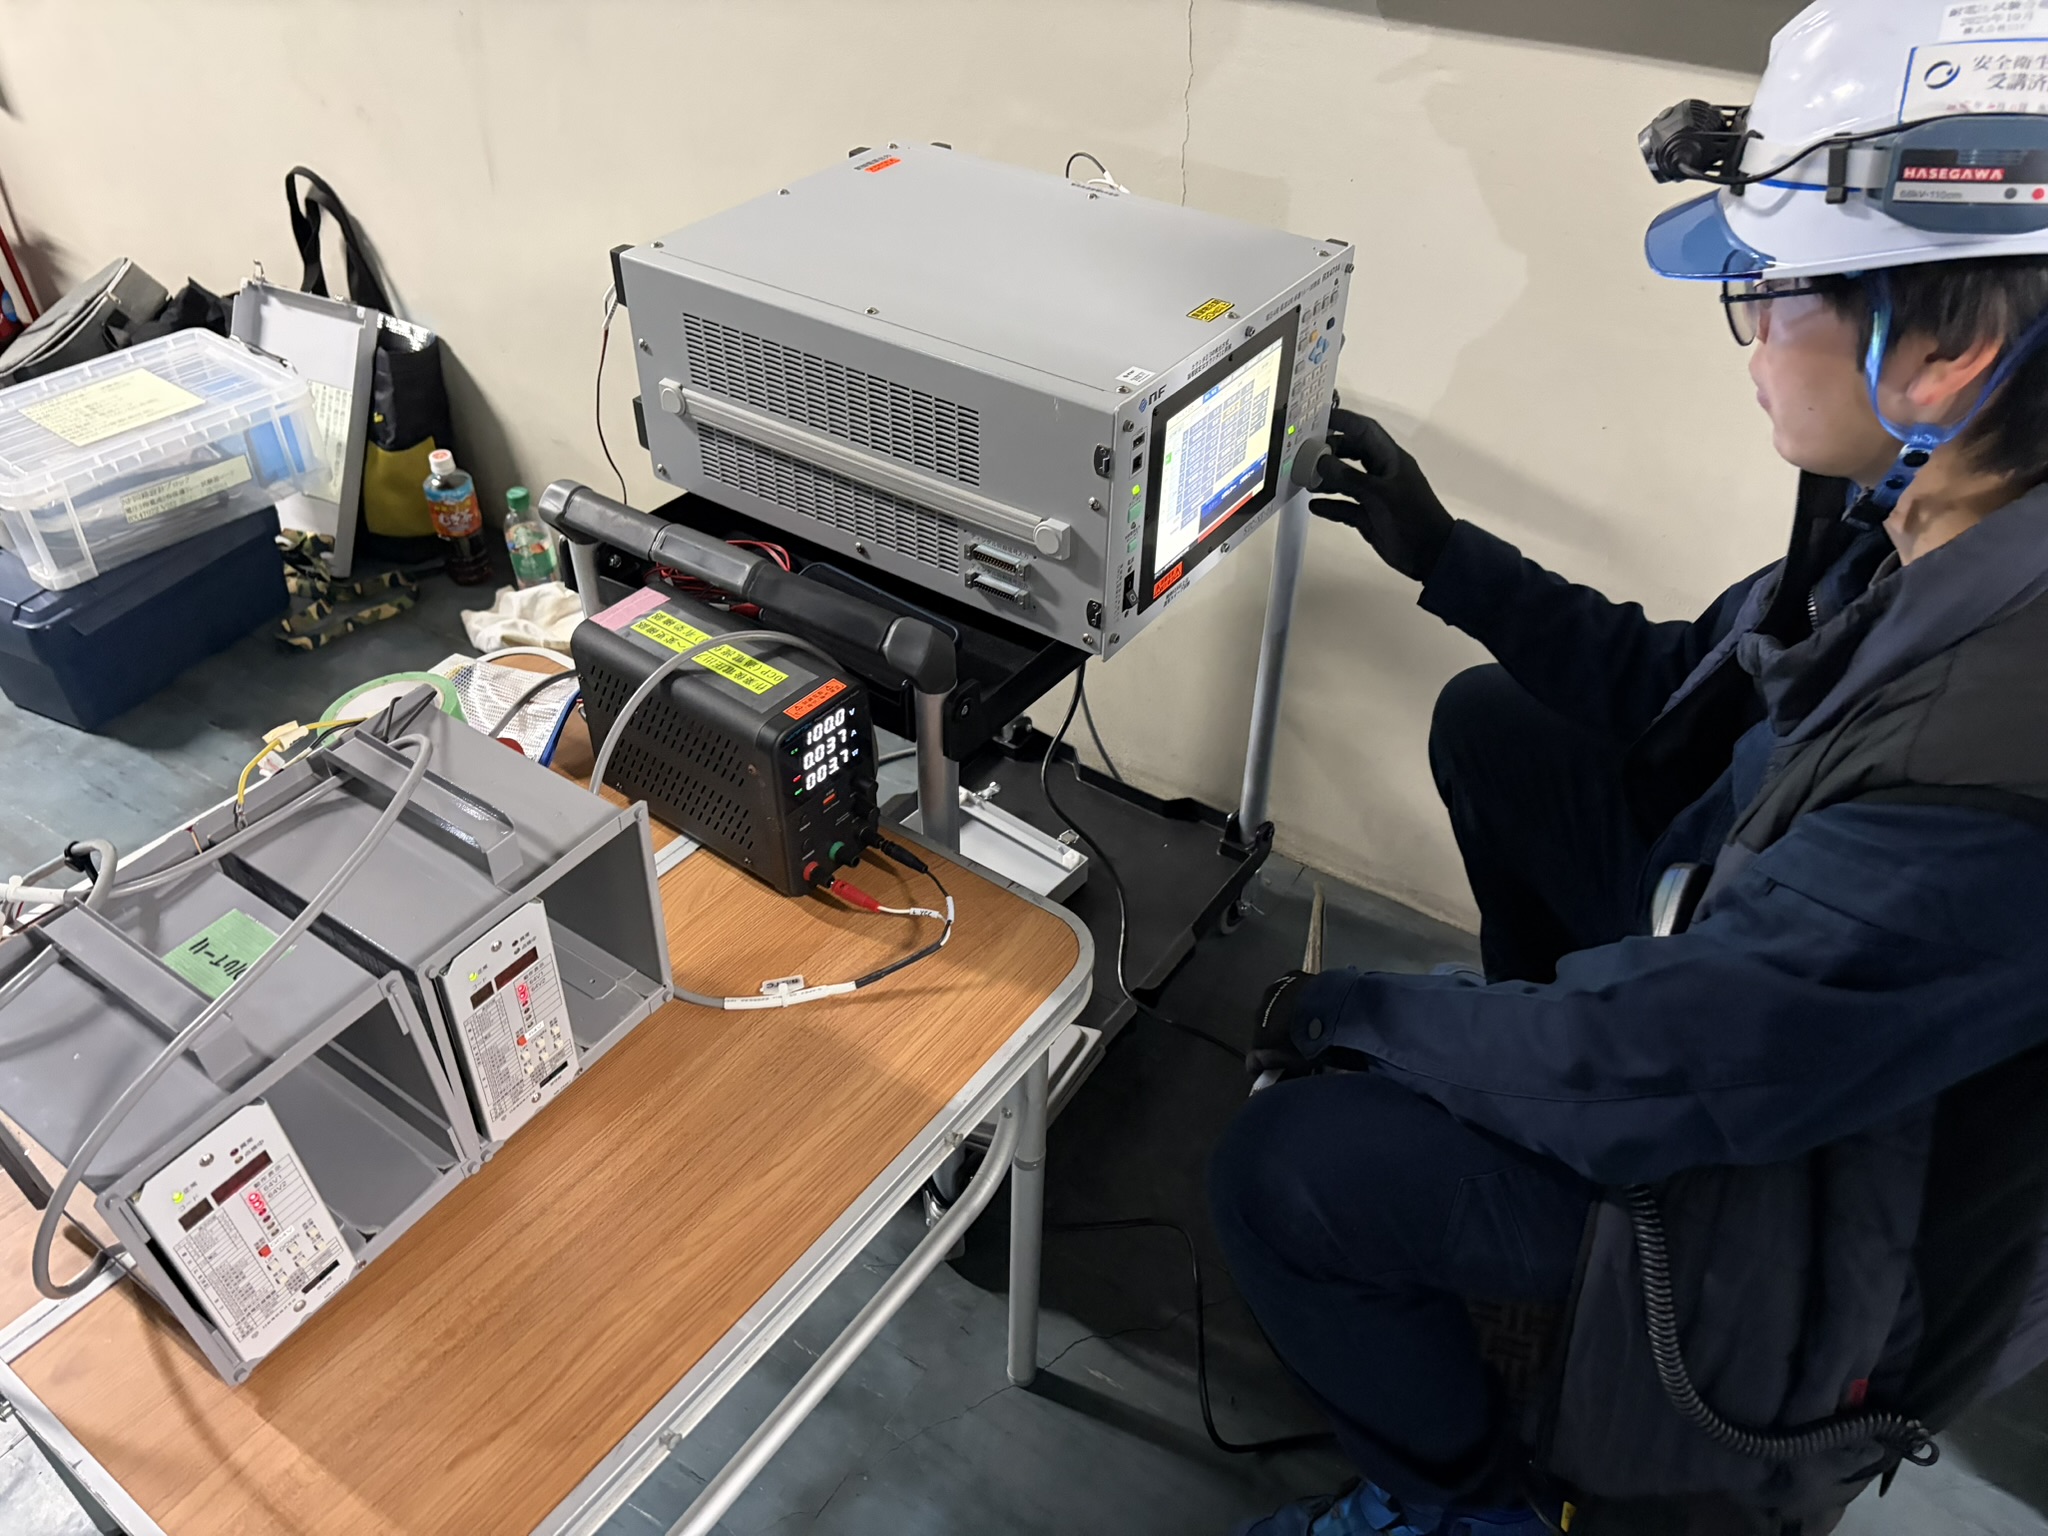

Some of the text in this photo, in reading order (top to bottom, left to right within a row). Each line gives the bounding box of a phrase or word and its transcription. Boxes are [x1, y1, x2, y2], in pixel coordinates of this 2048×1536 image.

[1903, 167, 2004, 181] HASEGAWA
[848, 707, 856, 716] V
[262, 1173, 283, 1191] 64V1
[266, 1180, 288, 1198] 64V2
